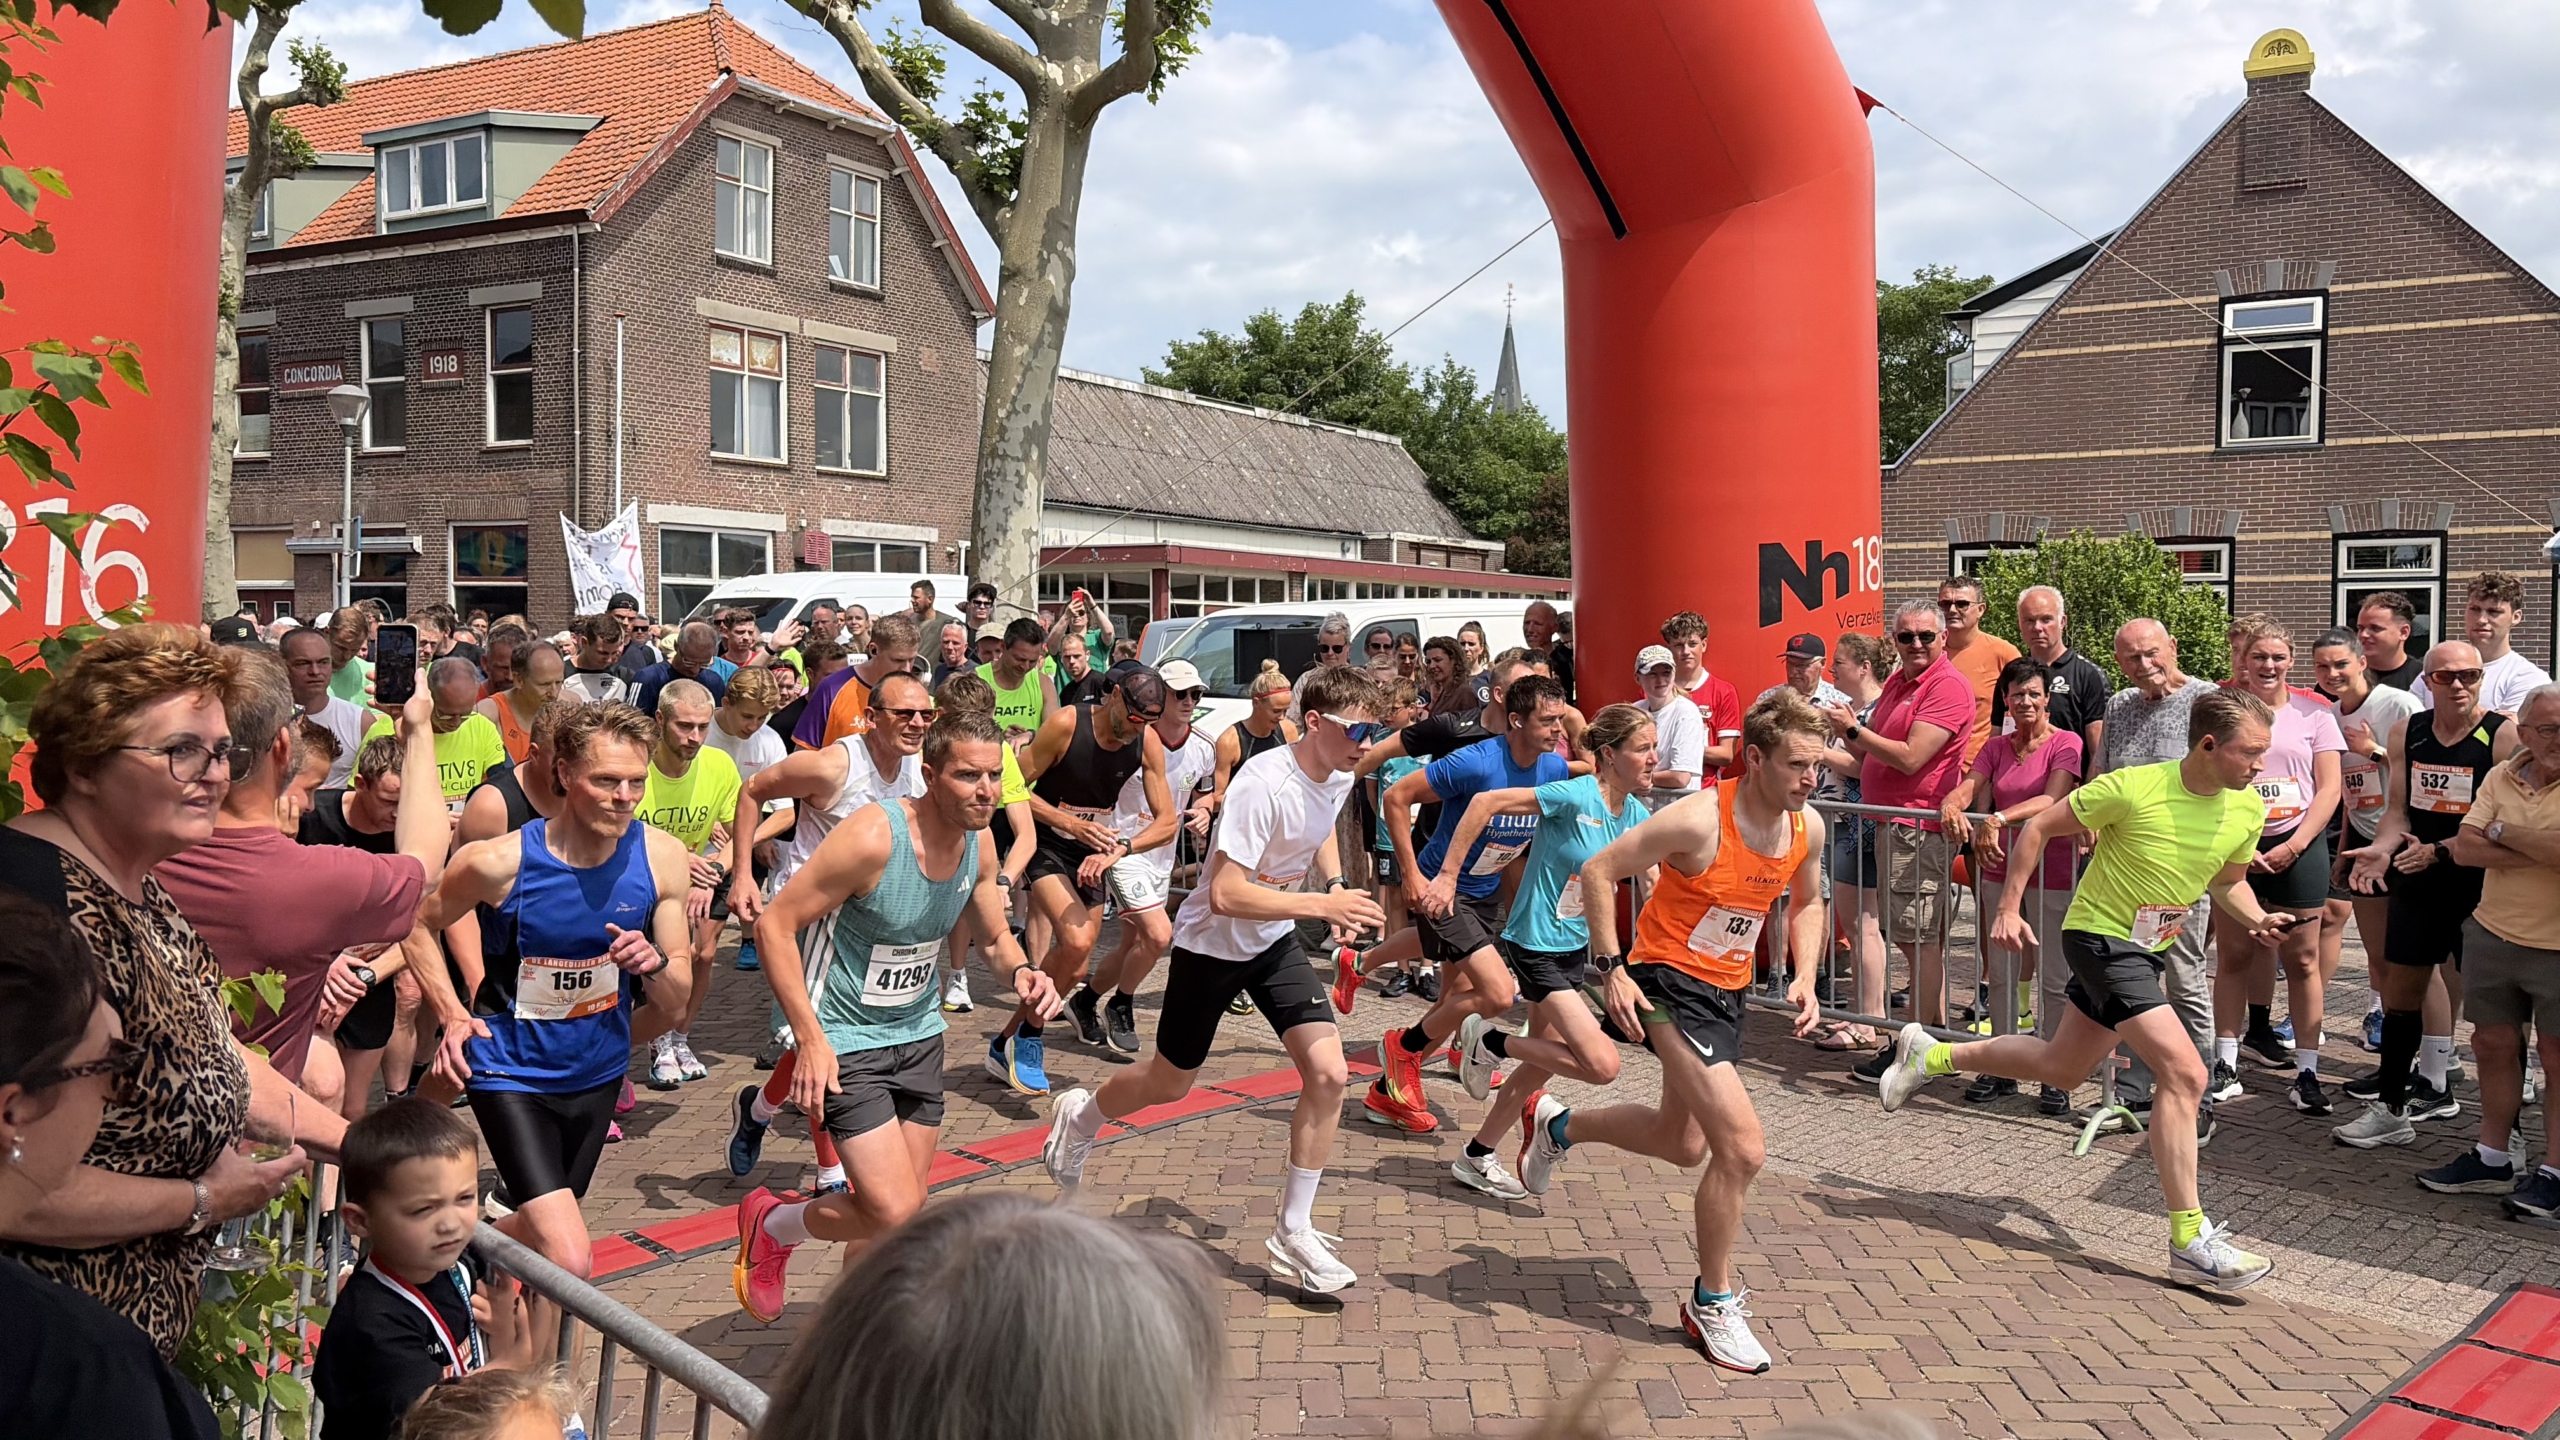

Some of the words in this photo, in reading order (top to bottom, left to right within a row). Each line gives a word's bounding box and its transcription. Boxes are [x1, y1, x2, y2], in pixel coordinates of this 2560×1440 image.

[284, 364, 343, 384] CONCORDIA
[429, 355, 458, 374] 1918
[1851, 535, 1883, 592] 18
[1836, 607, 1884, 629] Verzeke
[994, 706, 1027, 716] RAFT
[437, 760, 476, 781] TIV8
[2421, 772, 2449, 789] 532
[2345, 773, 2364, 789] 648
[639, 805, 709, 825] ACTIV8
[1486, 828, 1535, 839] Hypotheke
[1745, 876, 1782, 884] PALKIES
[1725, 916, 1753, 936] 133
[551, 970, 593, 990] 156
[875, 963, 931, 990] 41293
